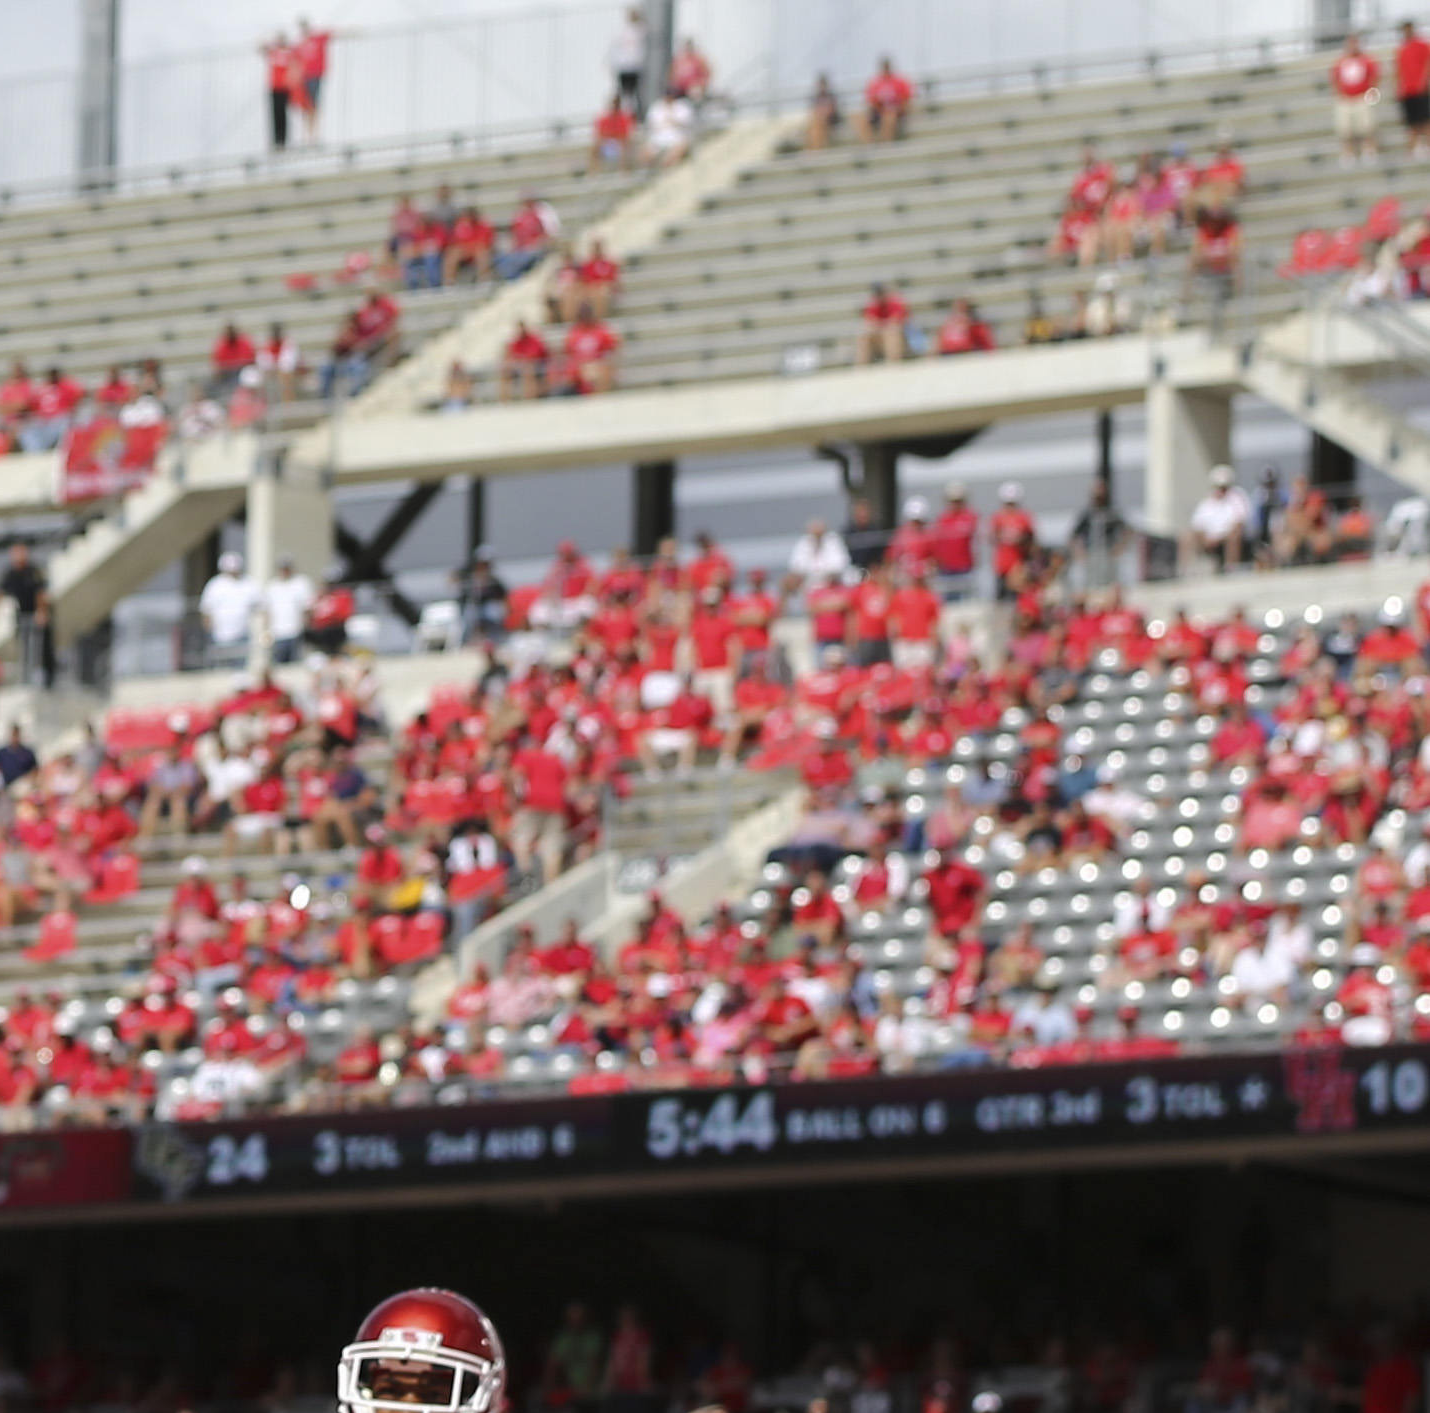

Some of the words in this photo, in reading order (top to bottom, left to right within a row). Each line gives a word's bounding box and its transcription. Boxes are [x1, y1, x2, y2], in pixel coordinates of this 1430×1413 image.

[1124, 1075, 1157, 1124] 3
[1361, 1059, 1427, 1114] 10
[646, 1090, 779, 1159] 5:44
[206, 1134, 270, 1185] 24
[311, 1129, 341, 1176] 3
